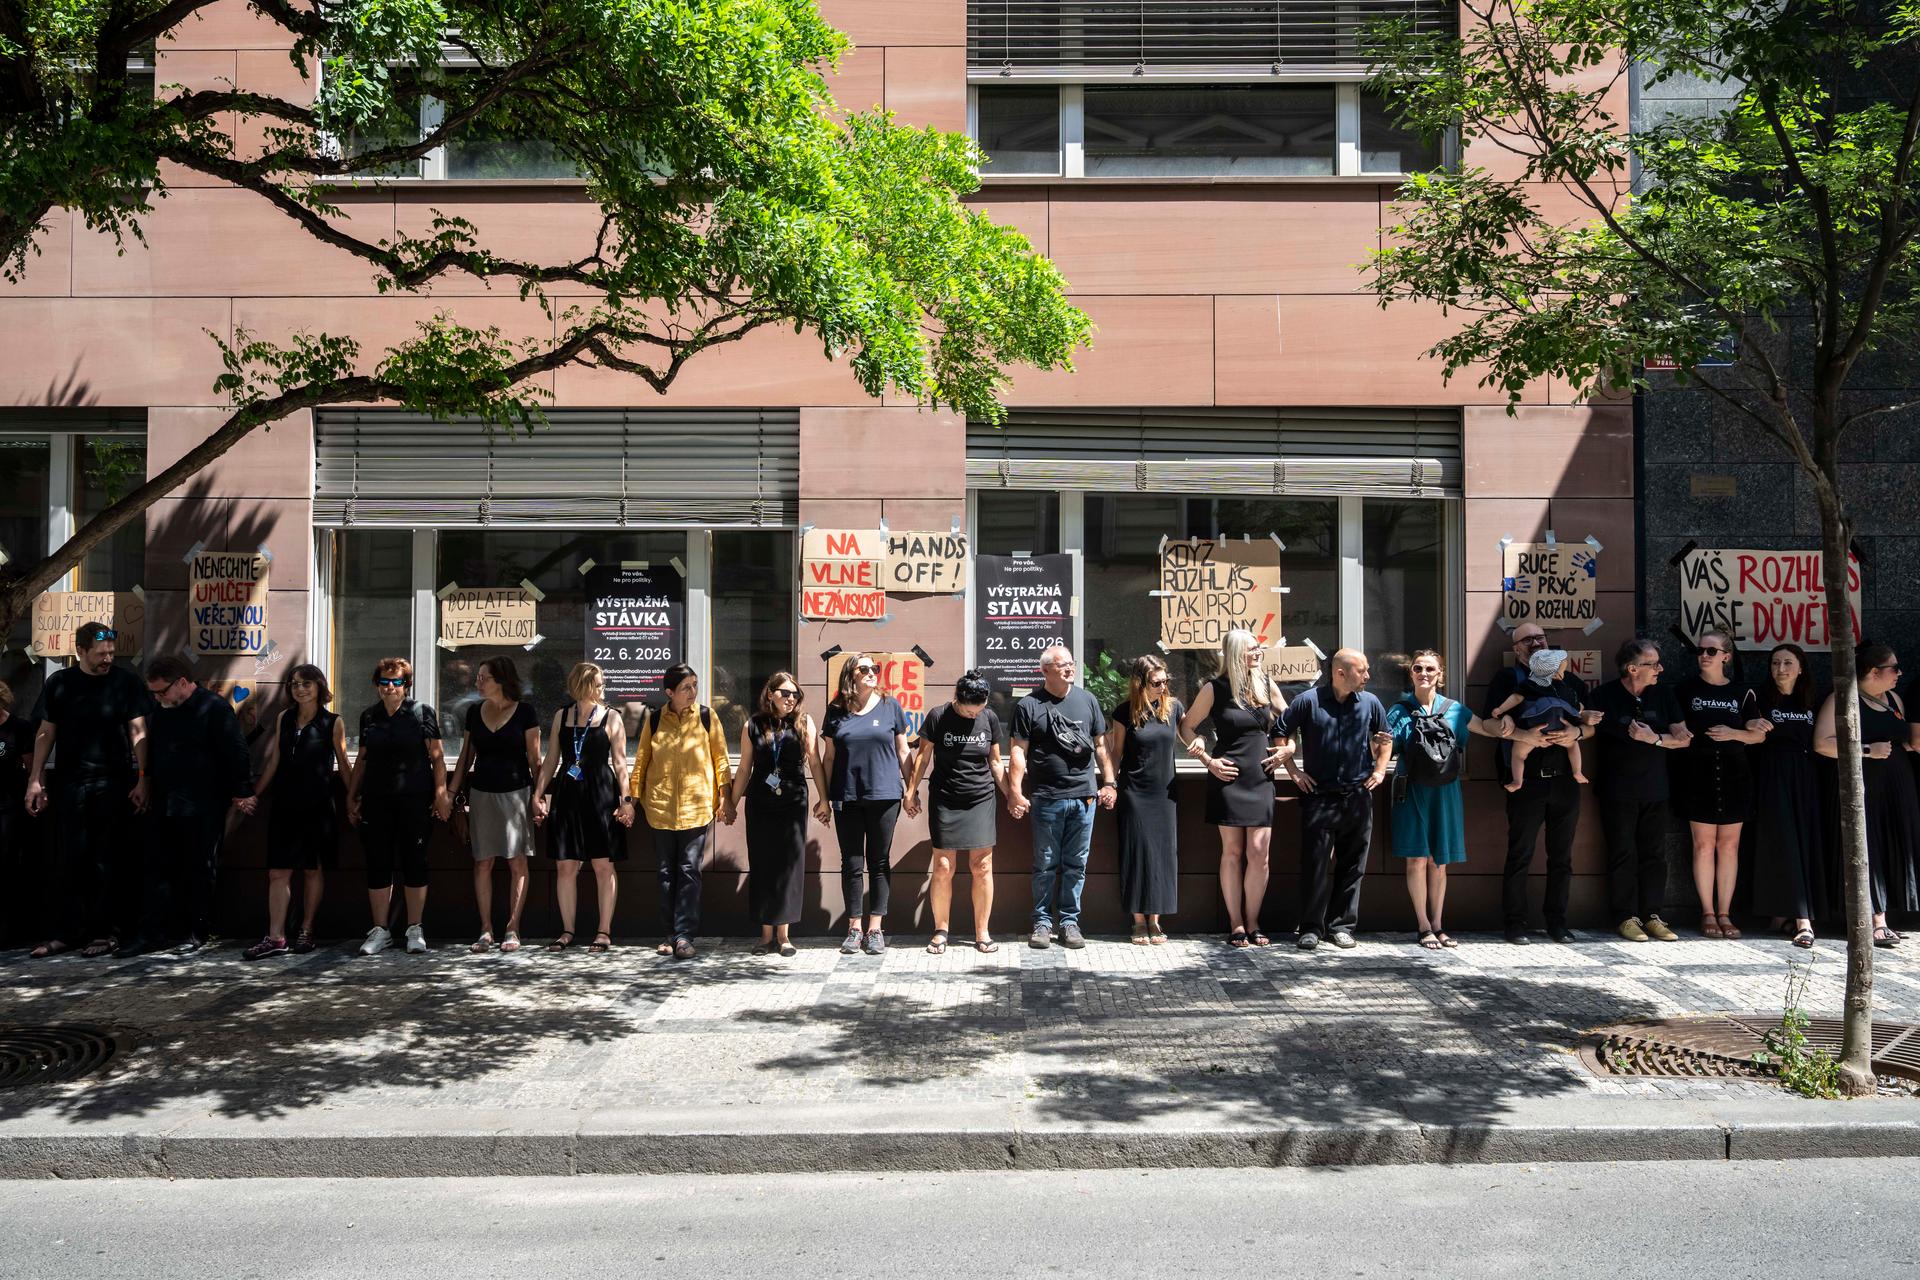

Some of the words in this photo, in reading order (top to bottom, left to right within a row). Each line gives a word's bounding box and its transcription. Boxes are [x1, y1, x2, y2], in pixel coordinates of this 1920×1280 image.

[826, 533, 861, 556] NA
[887, 536, 967, 559] HANDS
[194, 556, 261, 581] NENECHME
[810, 561, 872, 586] VLNĚ
[1518, 552, 1559, 575] RUCE
[1682, 551, 1730, 594] VÁŠ
[1737, 552, 1860, 594] ROZHLS
[195, 579, 256, 603] UMLČET
[987, 584, 1062, 597] VÝSTRAŽNÁ
[1538, 570, 1578, 596] PRYČ
[66, 595, 115, 613] CHCEME
[448, 591, 530, 612] POPLATEK
[596, 595, 670, 608] VÝSTRAŽNÁ
[803, 589, 886, 617] NEZÁVISLOSTI
[987, 597, 1063, 615] STÁVKA
[1162, 594, 1200, 618] TAK
[1206, 592, 1247, 616] PRO
[1509, 599, 1530, 619] OD
[1535, 599, 1596, 619] ROZHLASU
[38, 614, 83, 631] SLOUŽIT
[194, 603, 263, 625] VEŘEJNOU
[596, 608, 670, 626] STÁVKA
[1683, 595, 1746, 642] VAŠE
[1752, 595, 1861, 646] DŮVĚA
[198, 626, 262, 650] SLUŽBU
[445, 617, 536, 639] NEZÁVISLOST
[47, 634, 60, 650] NE
[986, 637, 1007, 650] 22.
[1011, 637, 1024, 650] 6.
[1028, 637, 1064, 650] 2026
[594, 648, 615, 660] 22.
[619, 648, 632, 660] 6.
[635, 648, 671, 660] 2026
[1702, 699, 1732, 708] STÁVKA
[1781, 711, 1808, 719] STÁVKA
[953, 734, 980, 742] STÁVKA
